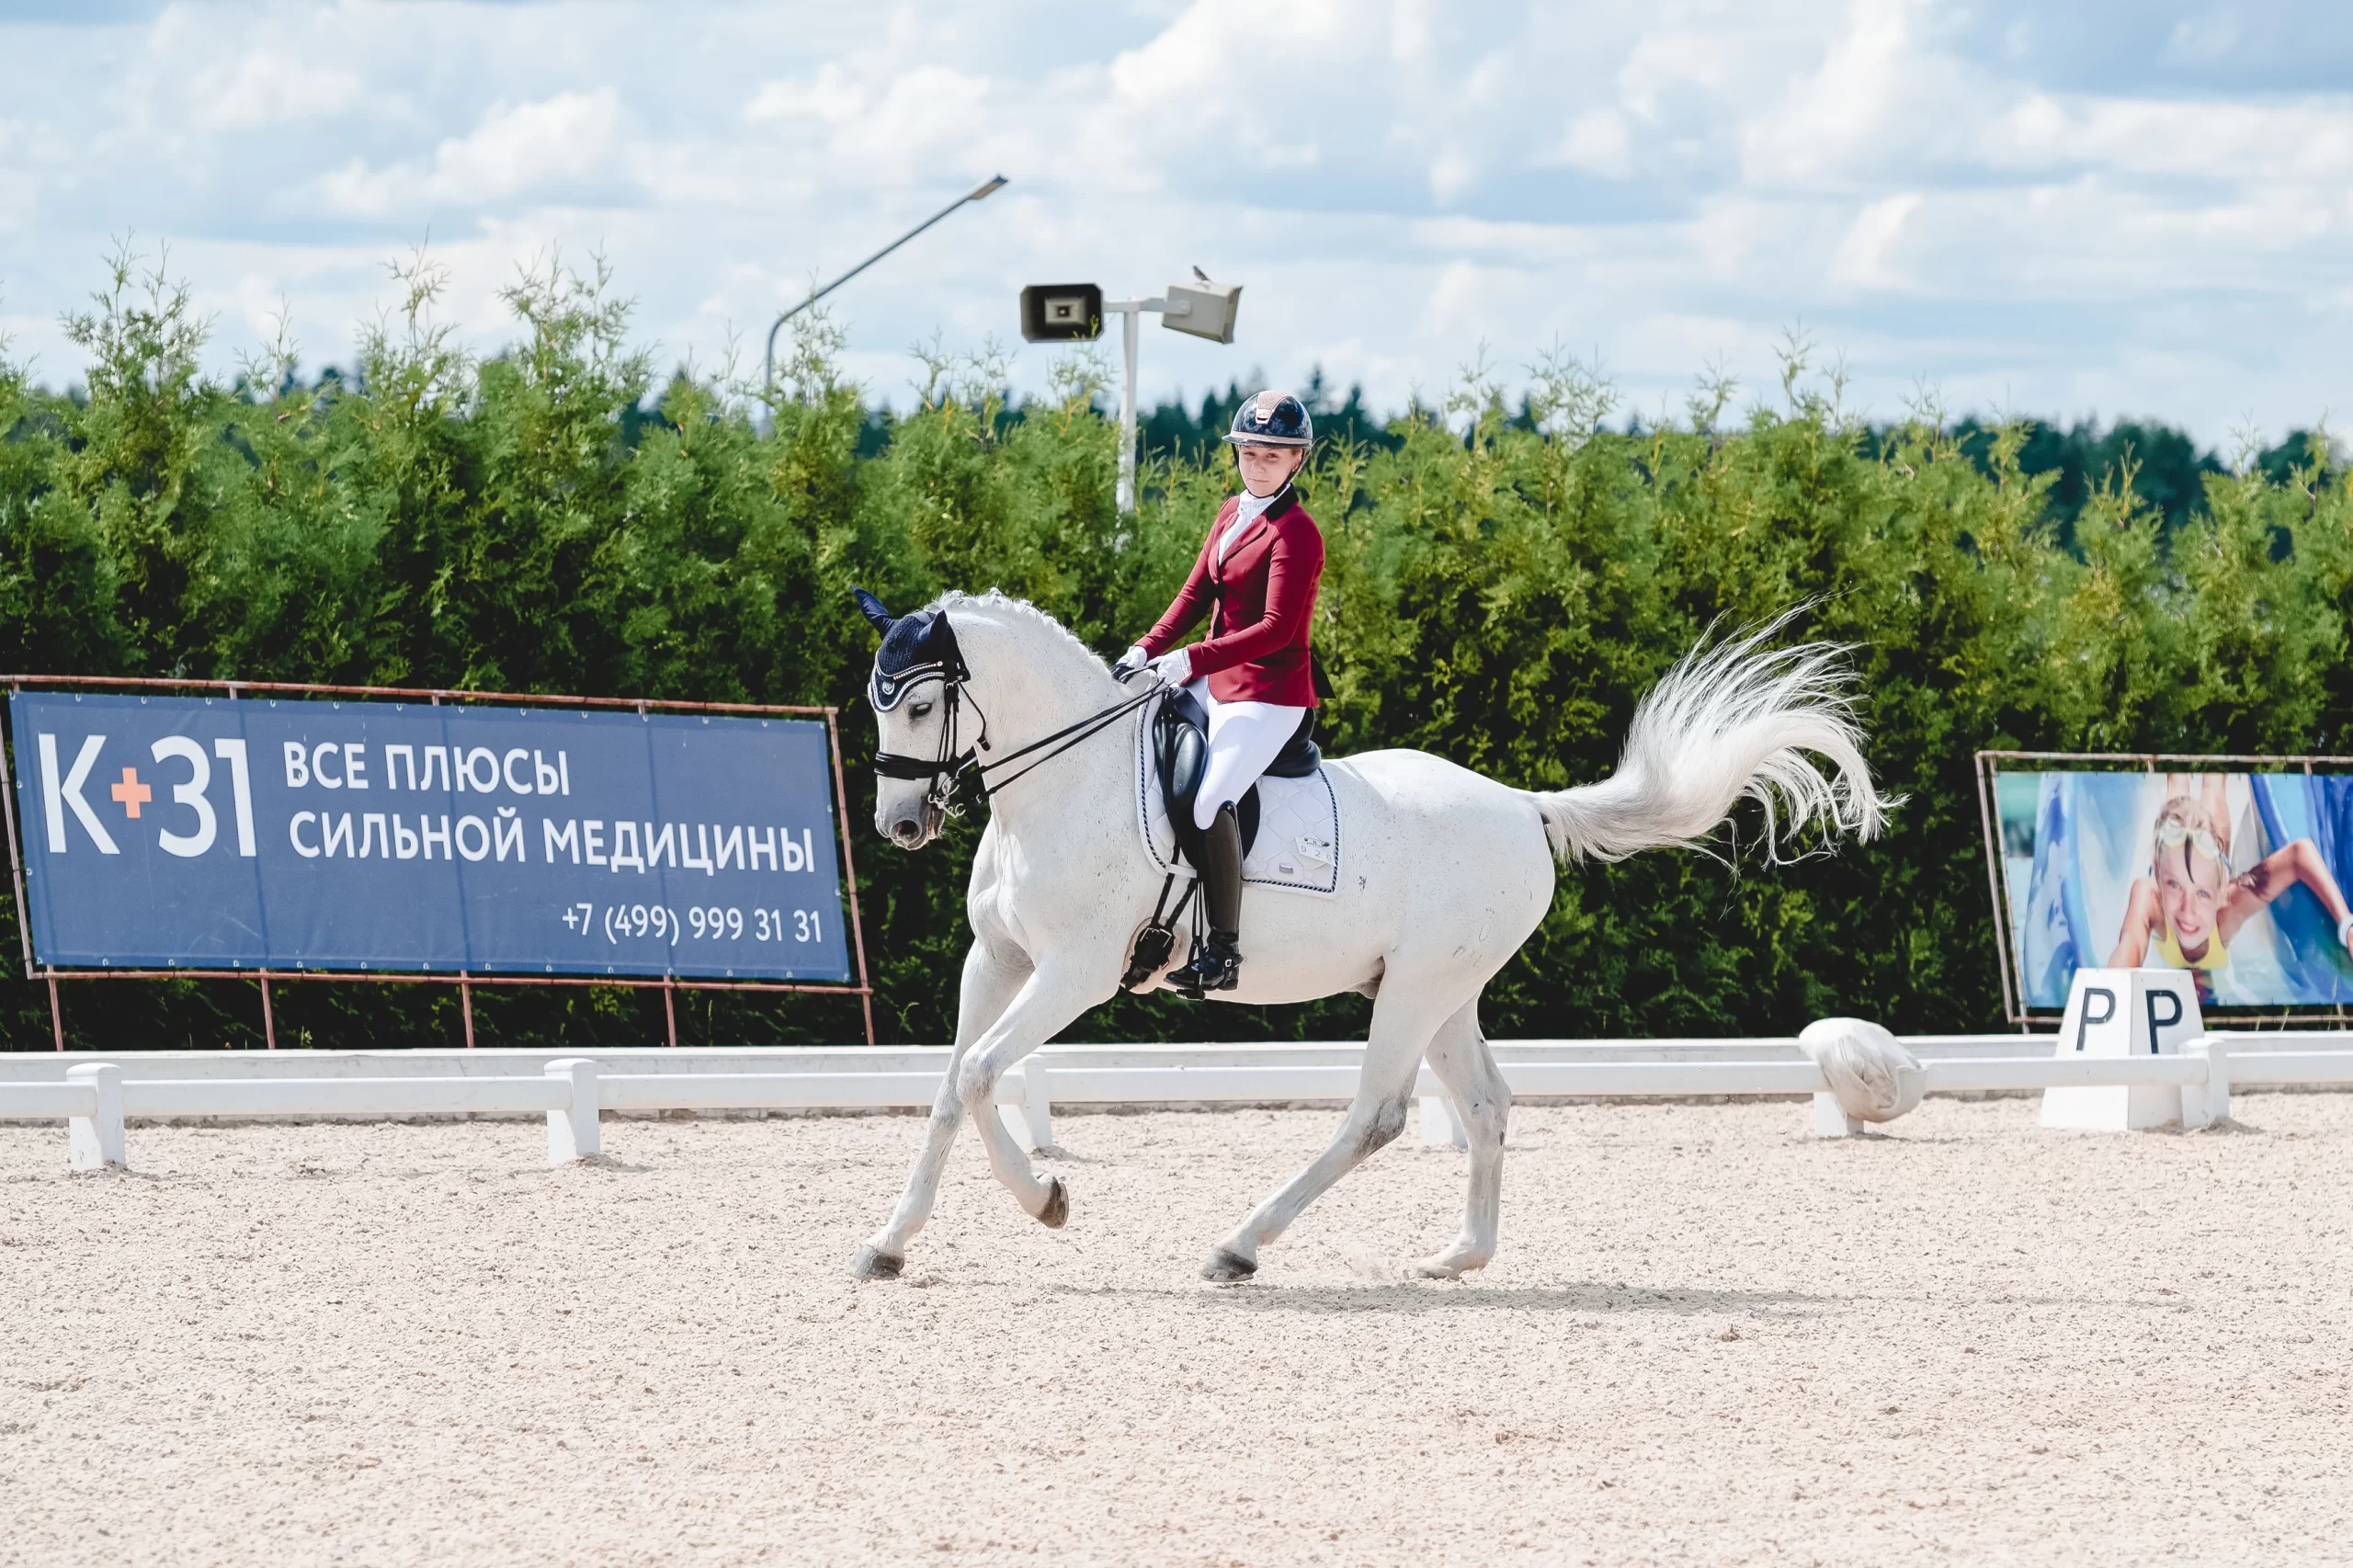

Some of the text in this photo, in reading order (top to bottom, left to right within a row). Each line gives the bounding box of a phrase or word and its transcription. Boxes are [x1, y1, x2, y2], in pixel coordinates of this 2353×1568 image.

[283, 741, 570, 796] ВСЕ ПЛЮСЫ
[290, 806, 814, 877] СИЛЬНОЙ МЕДИЦИНЫ
[1301, 846, 1332, 861] 920
[562, 903, 822, 947] +7 (499) 999 31 31
[2075, 987, 2116, 1051] P
[2145, 990, 2182, 1054] P
